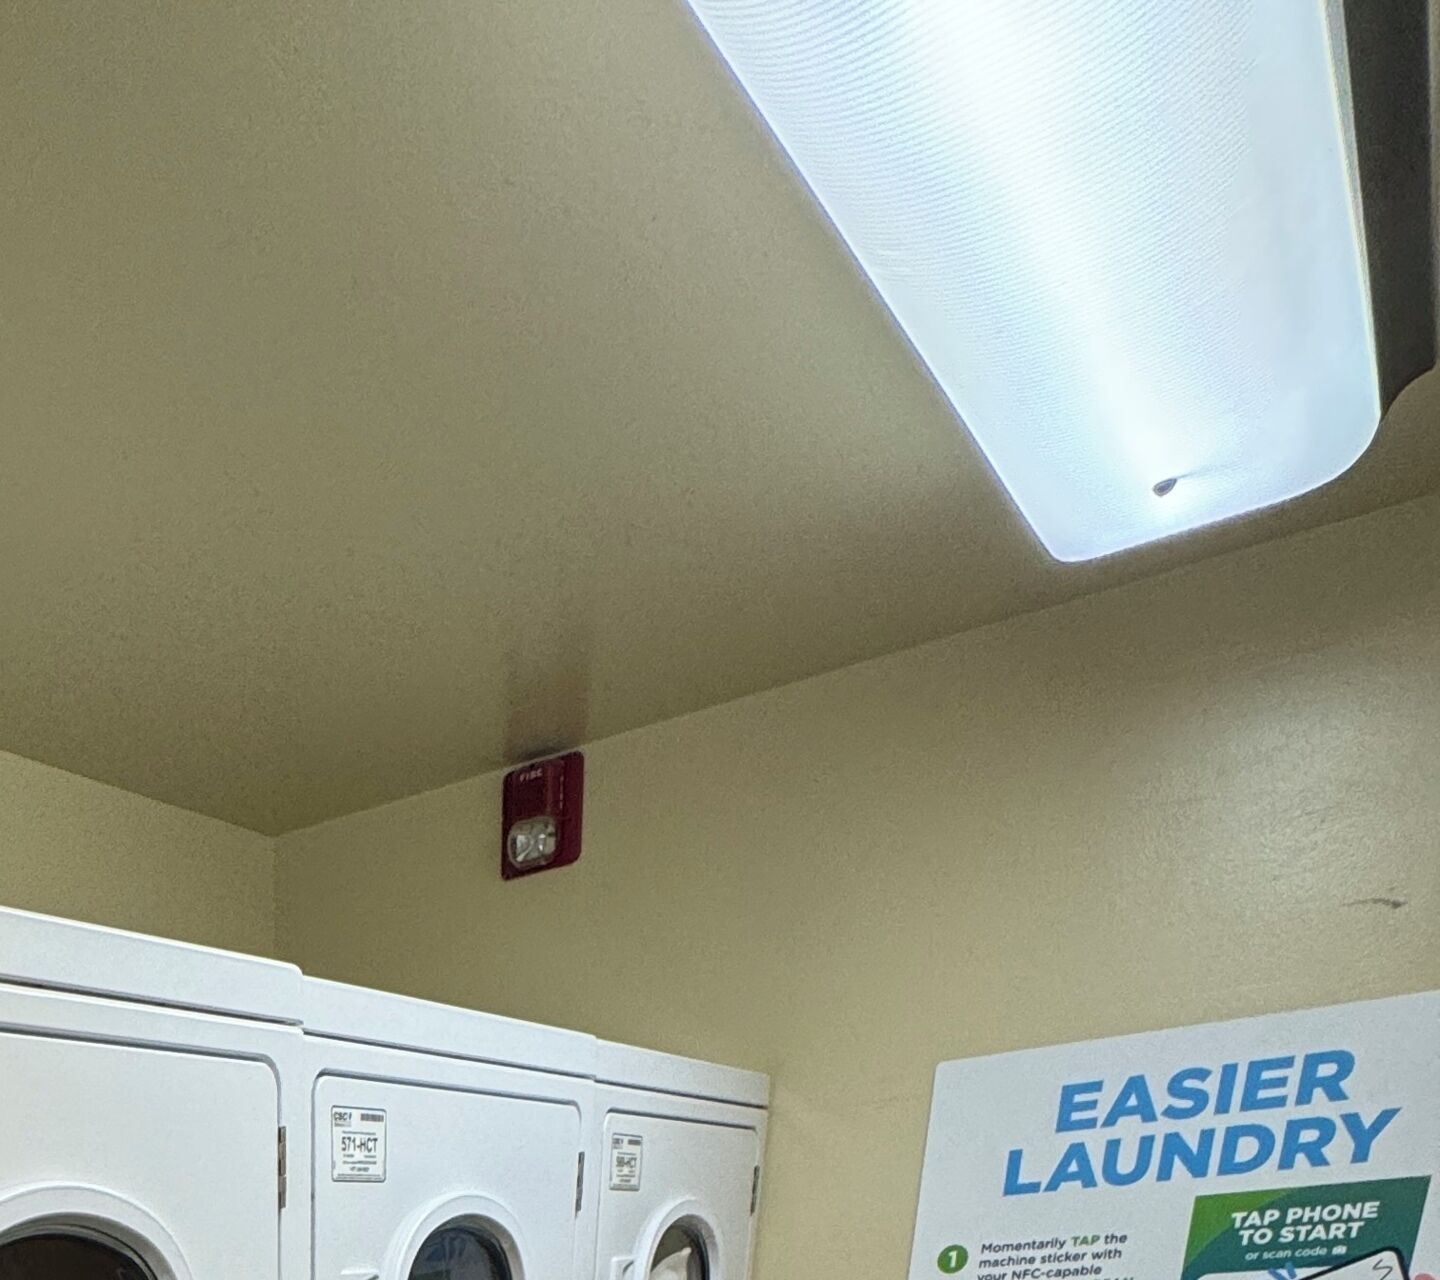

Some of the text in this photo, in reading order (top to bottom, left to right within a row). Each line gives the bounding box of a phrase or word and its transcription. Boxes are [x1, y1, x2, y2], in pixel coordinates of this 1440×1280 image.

[1055, 1049, 1355, 1133] EASIER
[1002, 1107, 1402, 1196] LAUNDRY
[1232, 1201, 1380, 1229] TAP PHONE
[982, 1233, 1128, 1254] Momentarily TAP the
[1238, 1221, 1365, 1246] TO START
[979, 1249, 1122, 1268] machine sticker with
[1245, 1246, 1327, 1260] or scan code
[1012, 1265, 1102, 1280] NFC-capable
